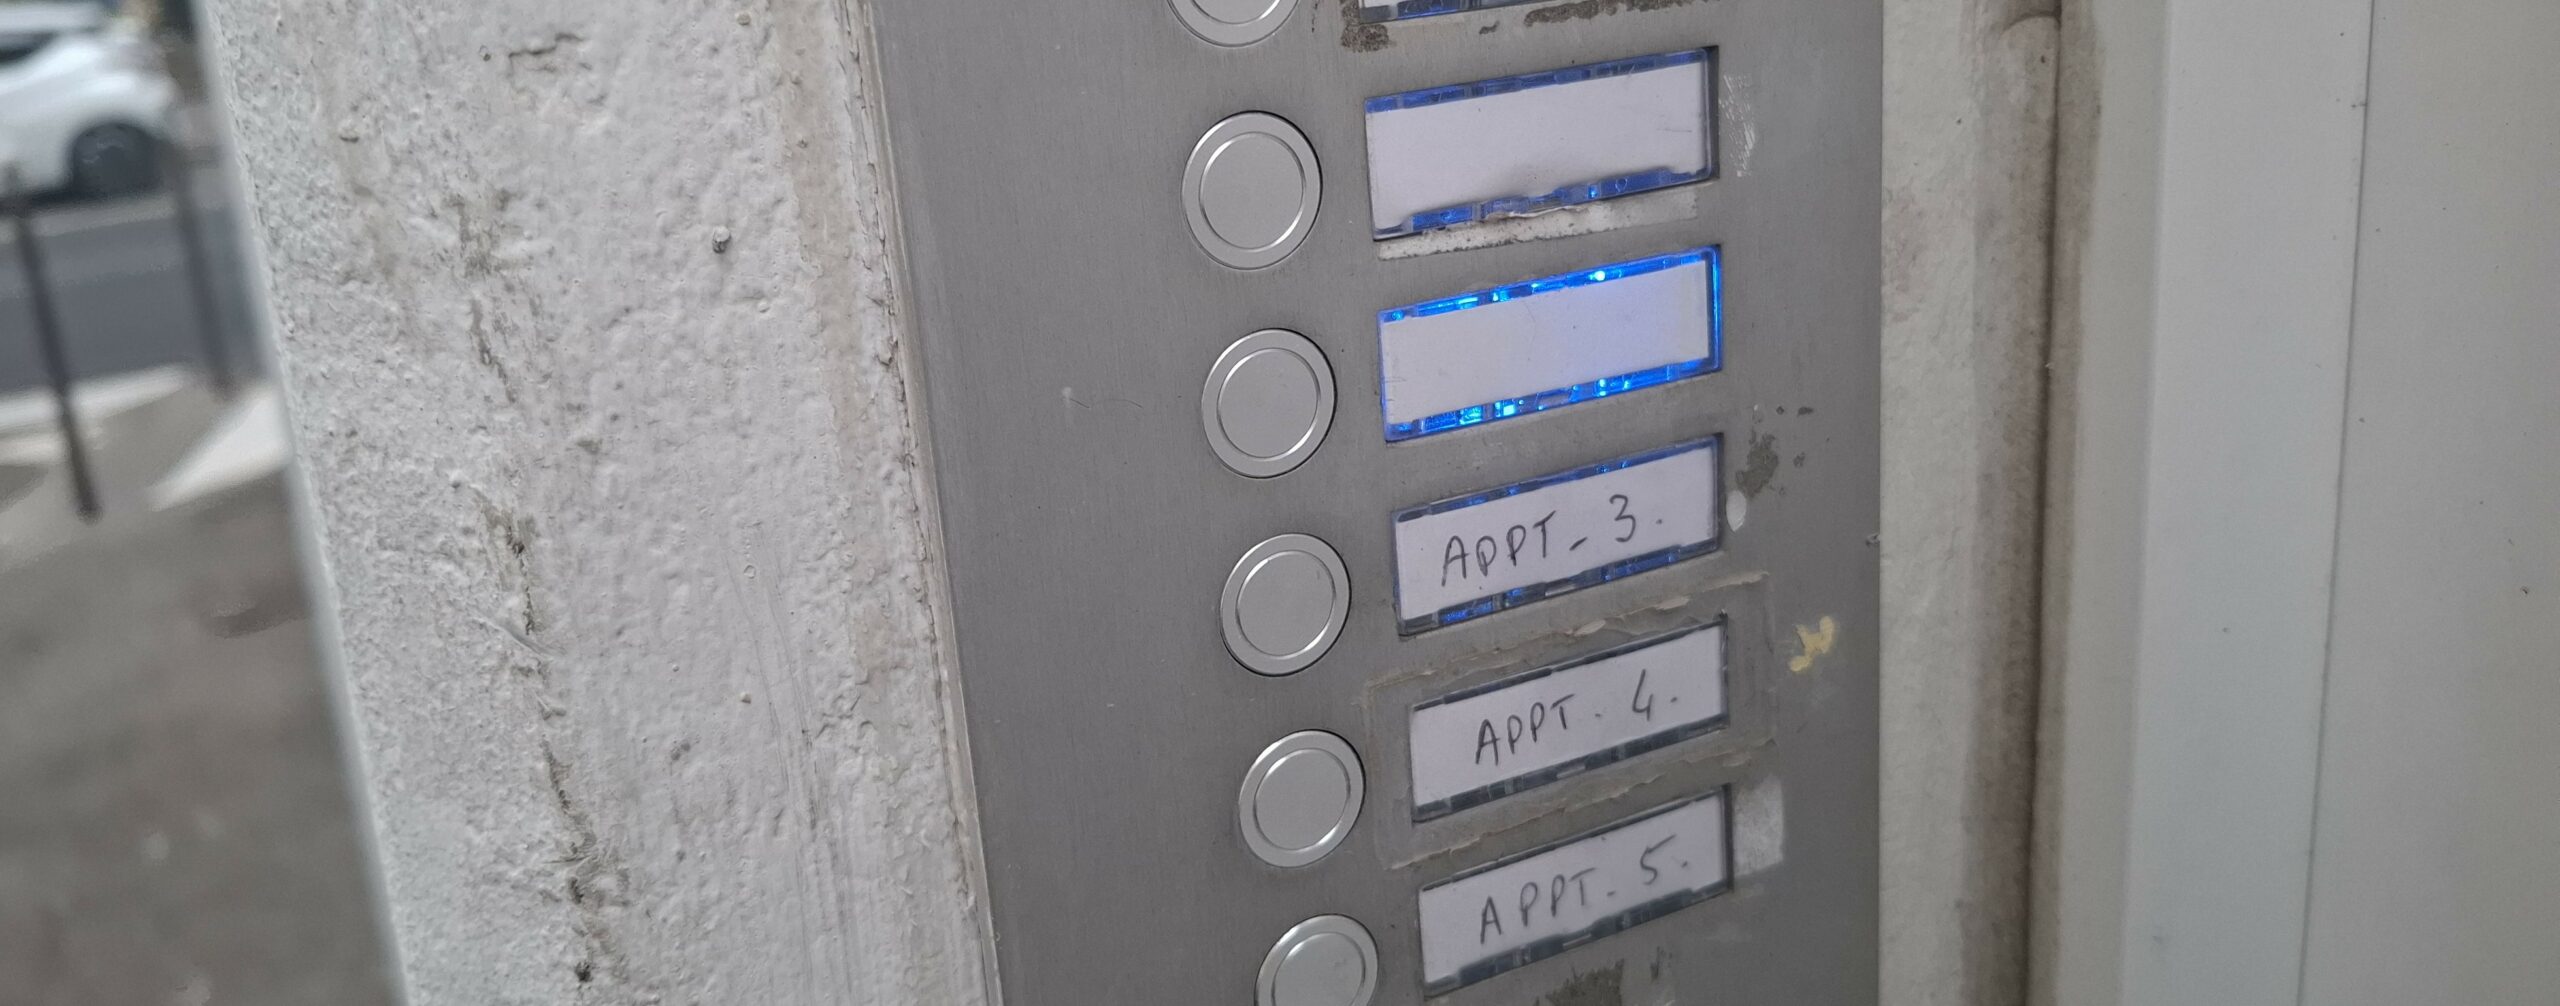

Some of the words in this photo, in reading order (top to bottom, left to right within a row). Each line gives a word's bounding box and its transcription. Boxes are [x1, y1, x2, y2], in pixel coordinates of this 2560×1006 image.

[1441, 510, 1557, 586] APPT
[1475, 693, 1575, 766] APPT
[1480, 867, 1596, 944] APPT
